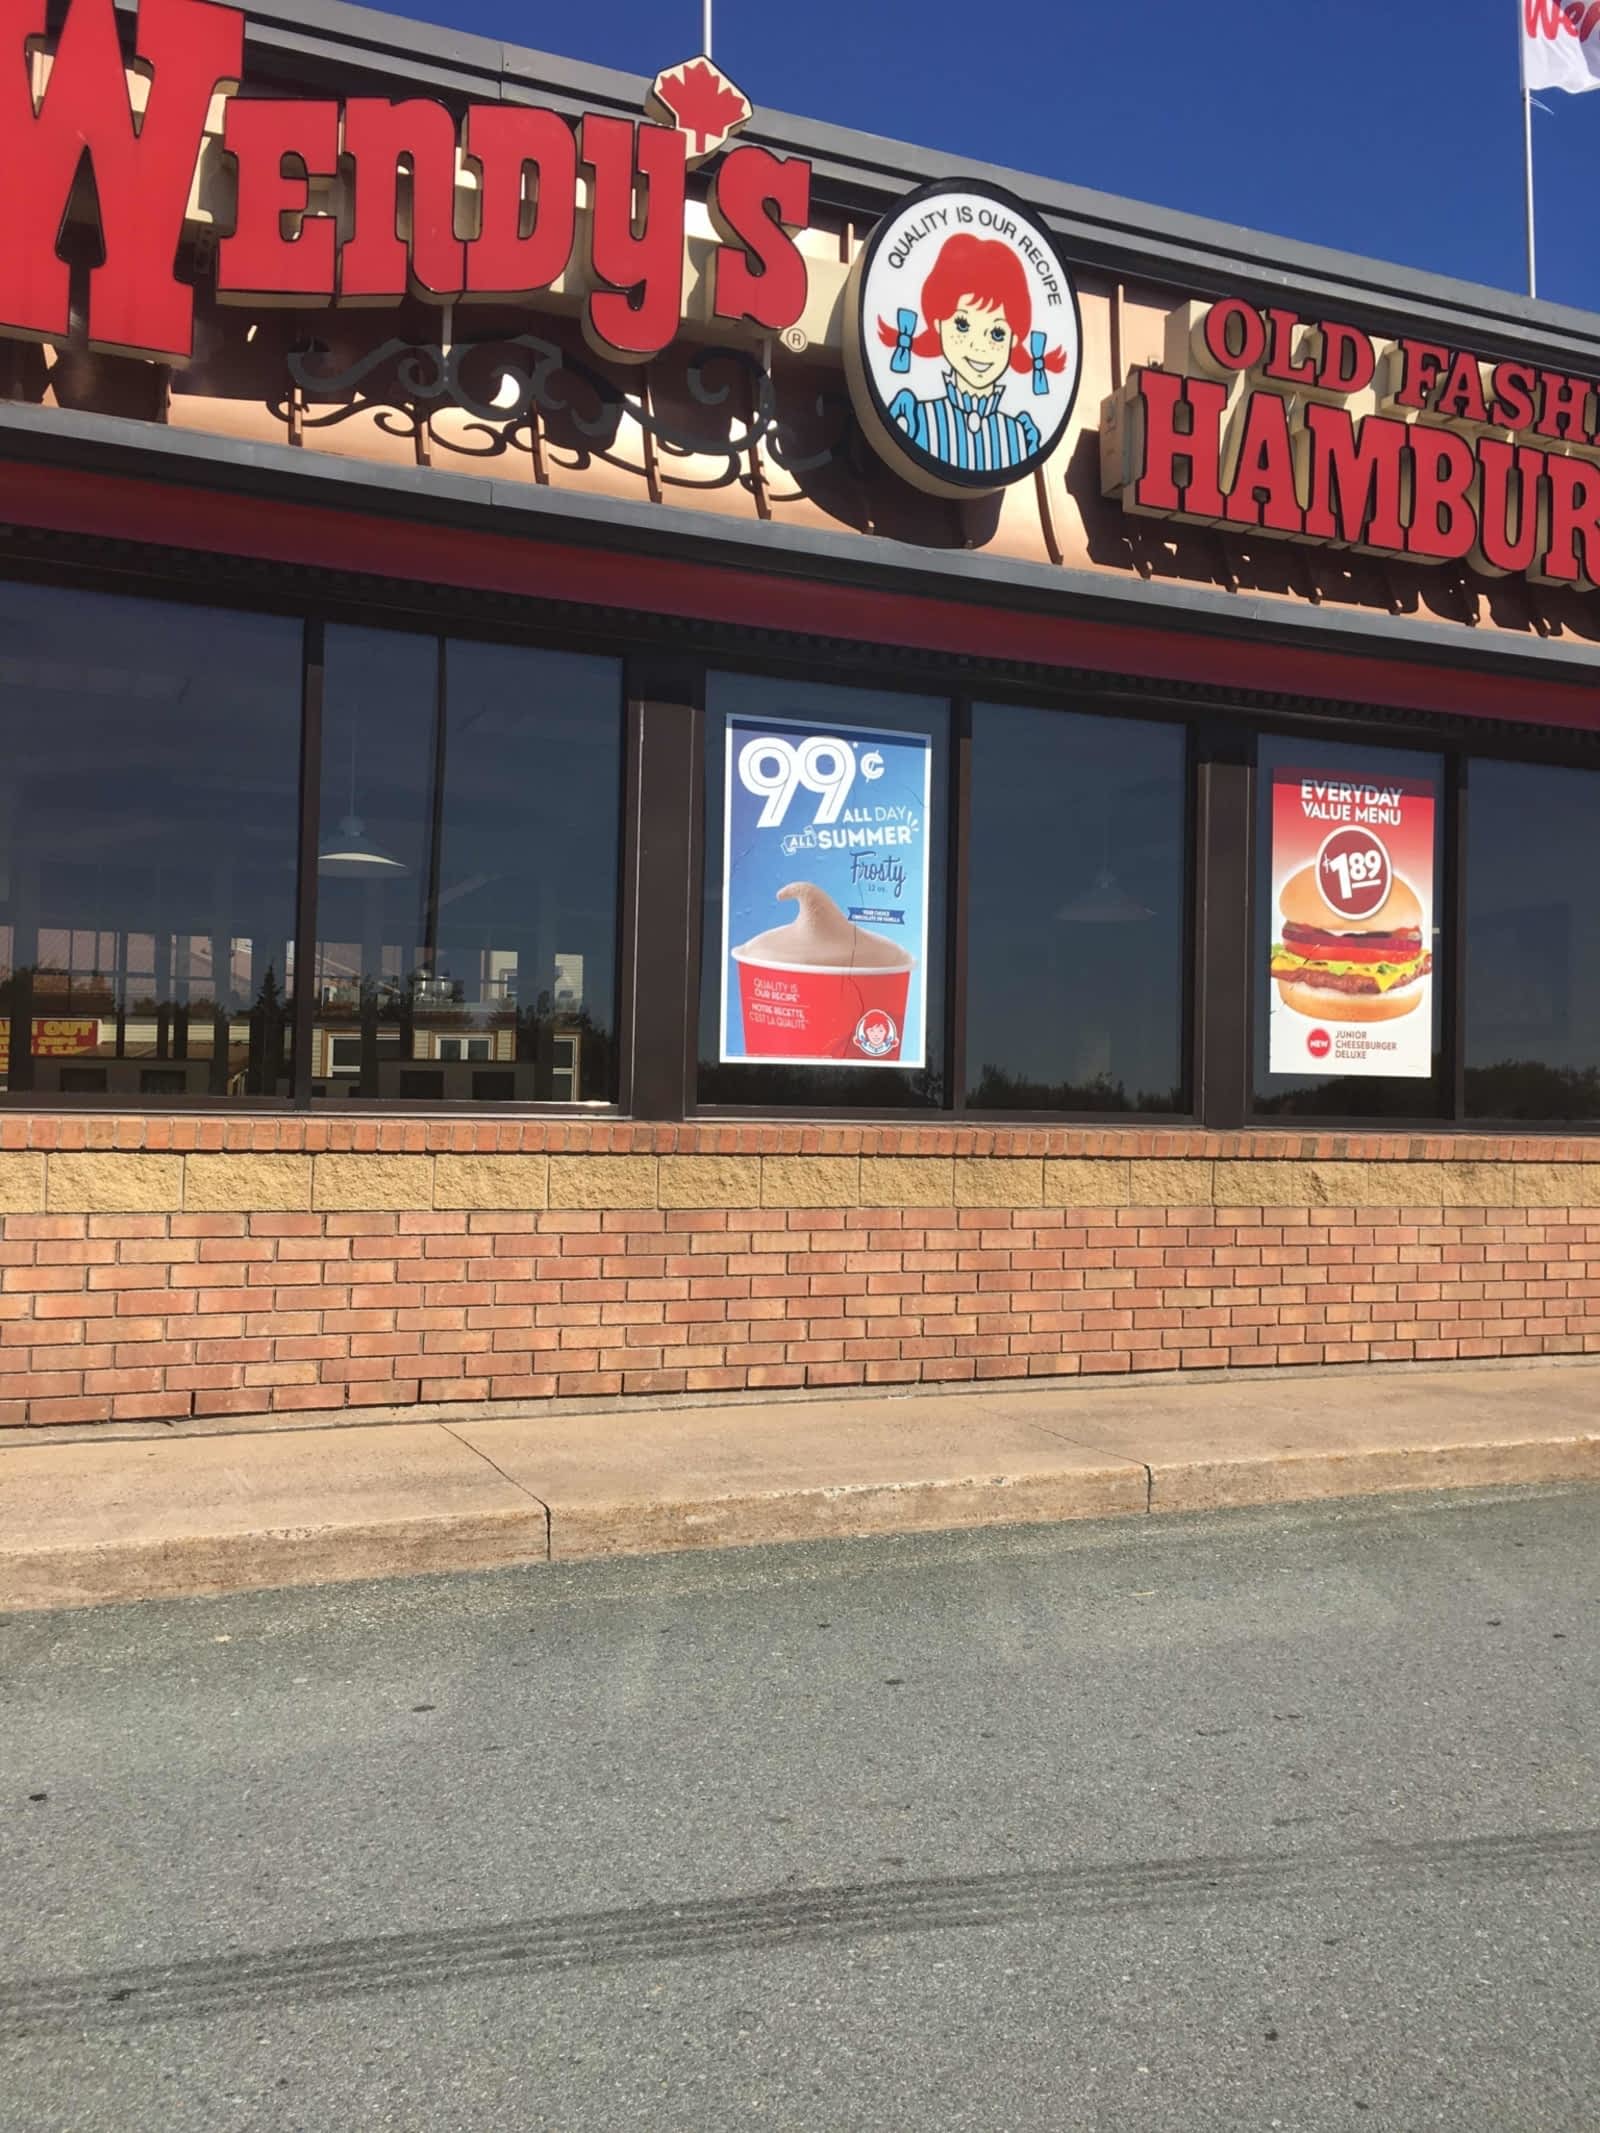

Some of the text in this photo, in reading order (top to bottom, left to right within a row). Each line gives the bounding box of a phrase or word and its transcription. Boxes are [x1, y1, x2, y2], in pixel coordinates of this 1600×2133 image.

[888, 206, 1062, 307] QUALITY IS OUR RECIPE
[1203, 298, 1600, 447] OLD FASH
[1301, 779, 1403, 808] EVERYDAY
[843, 805, 907, 823] ALL DAY
[1302, 801, 1402, 826] VALUE MENU
[789, 825, 913, 849] ALL SUMMER
[850, 850, 907, 898] Frosty
[753, 976, 799, 993] QUALITY IS
[754, 988, 771, 999] OUR
[43, 1021, 94, 1036] OUT
[1335, 1030, 1368, 1040] JUNIOR
[1310, 1039, 1330, 1049] NEW
[1335, 1040, 1397, 1051] CHEESEBURGER
[1335, 1050, 1367, 1060] DELUXE
